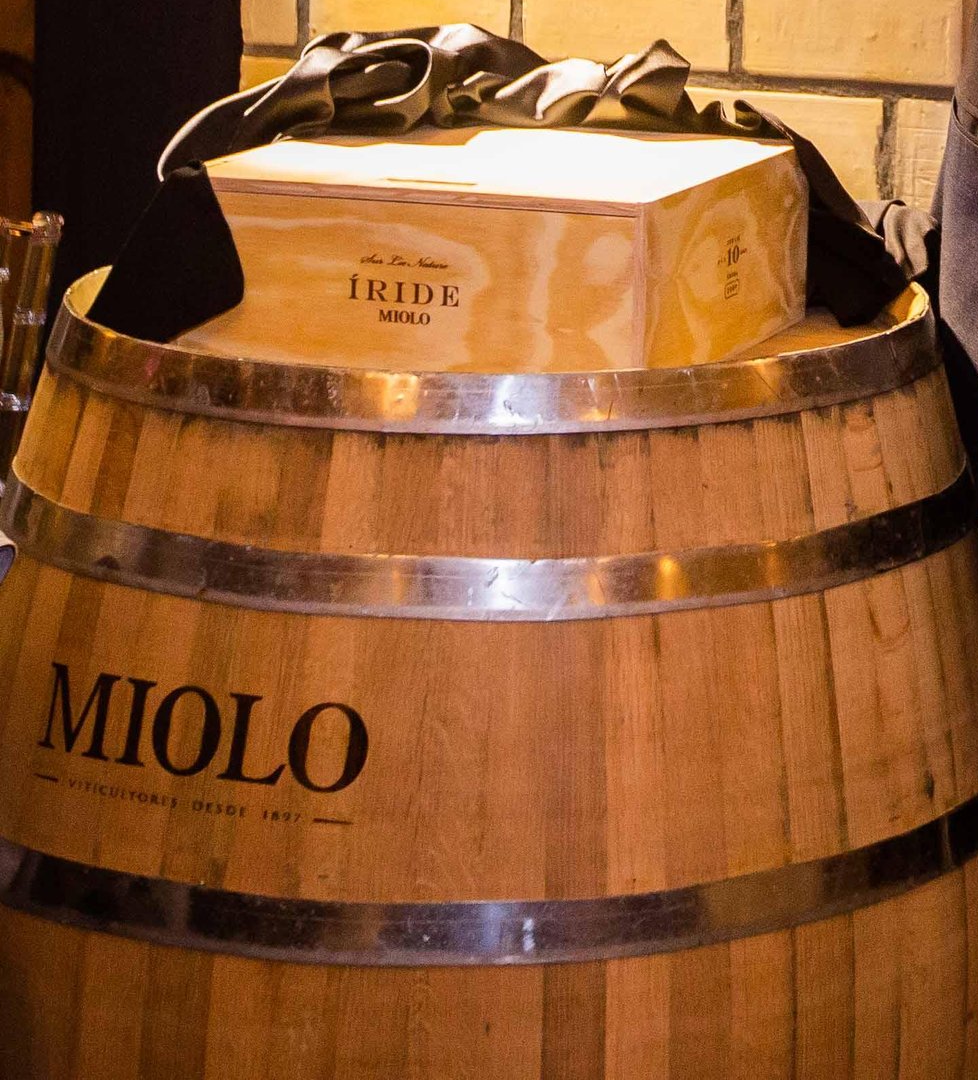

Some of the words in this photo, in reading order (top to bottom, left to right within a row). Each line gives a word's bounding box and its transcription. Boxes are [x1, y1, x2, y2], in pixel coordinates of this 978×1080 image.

[360, 253, 383, 266] Sur
[407, 257, 449, 269] Nature
[728, 245, 740, 266] 10
[348, 274, 460, 307] ÍRIDE
[378, 309, 431, 325] MIOLO
[37, 662, 369, 793] MIOLO
[191, 799, 246, 818] DESDE
[262, 809, 302, 823] 1897
